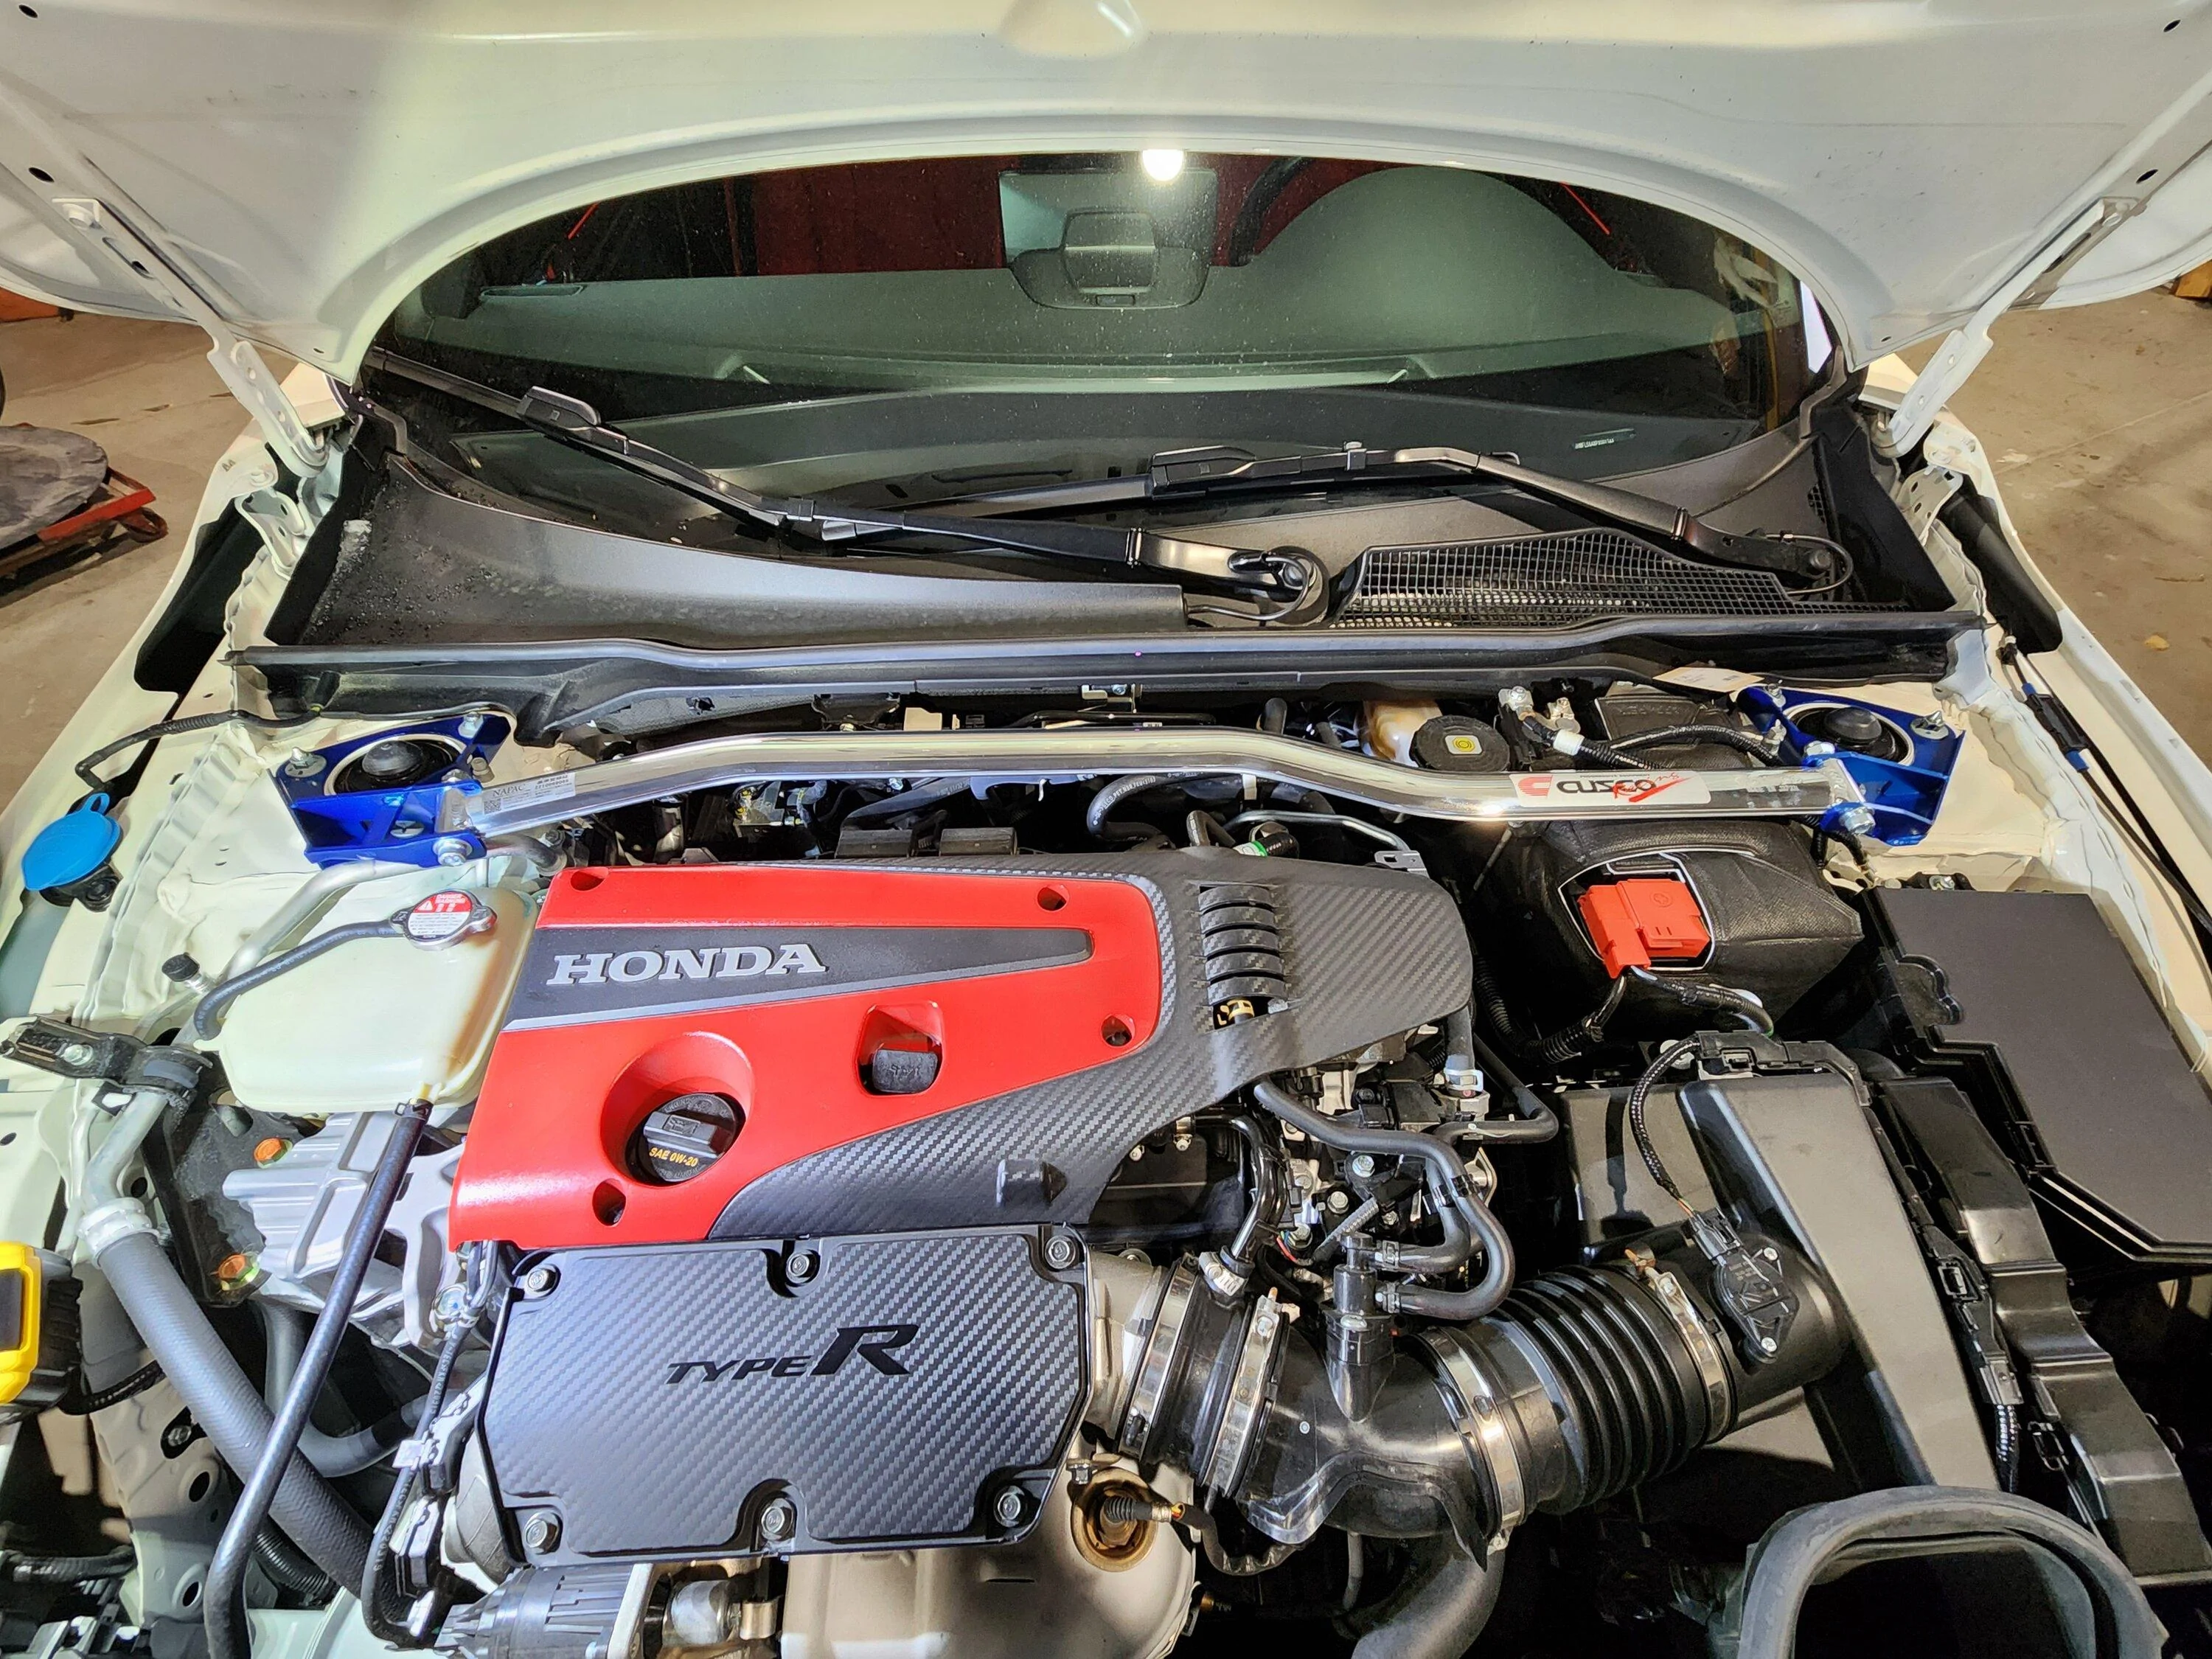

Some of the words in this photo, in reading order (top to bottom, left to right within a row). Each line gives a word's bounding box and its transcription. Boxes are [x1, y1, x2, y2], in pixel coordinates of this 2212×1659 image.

[493, 784, 526, 796] NAPAC
[546, 943, 827, 985] HONDA
[649, 1147, 670, 1160] SAE
[669, 1152, 698, 1167] 0W-20
[666, 1355, 811, 1384] TYPE
[810, 1324, 919, 1375] R
